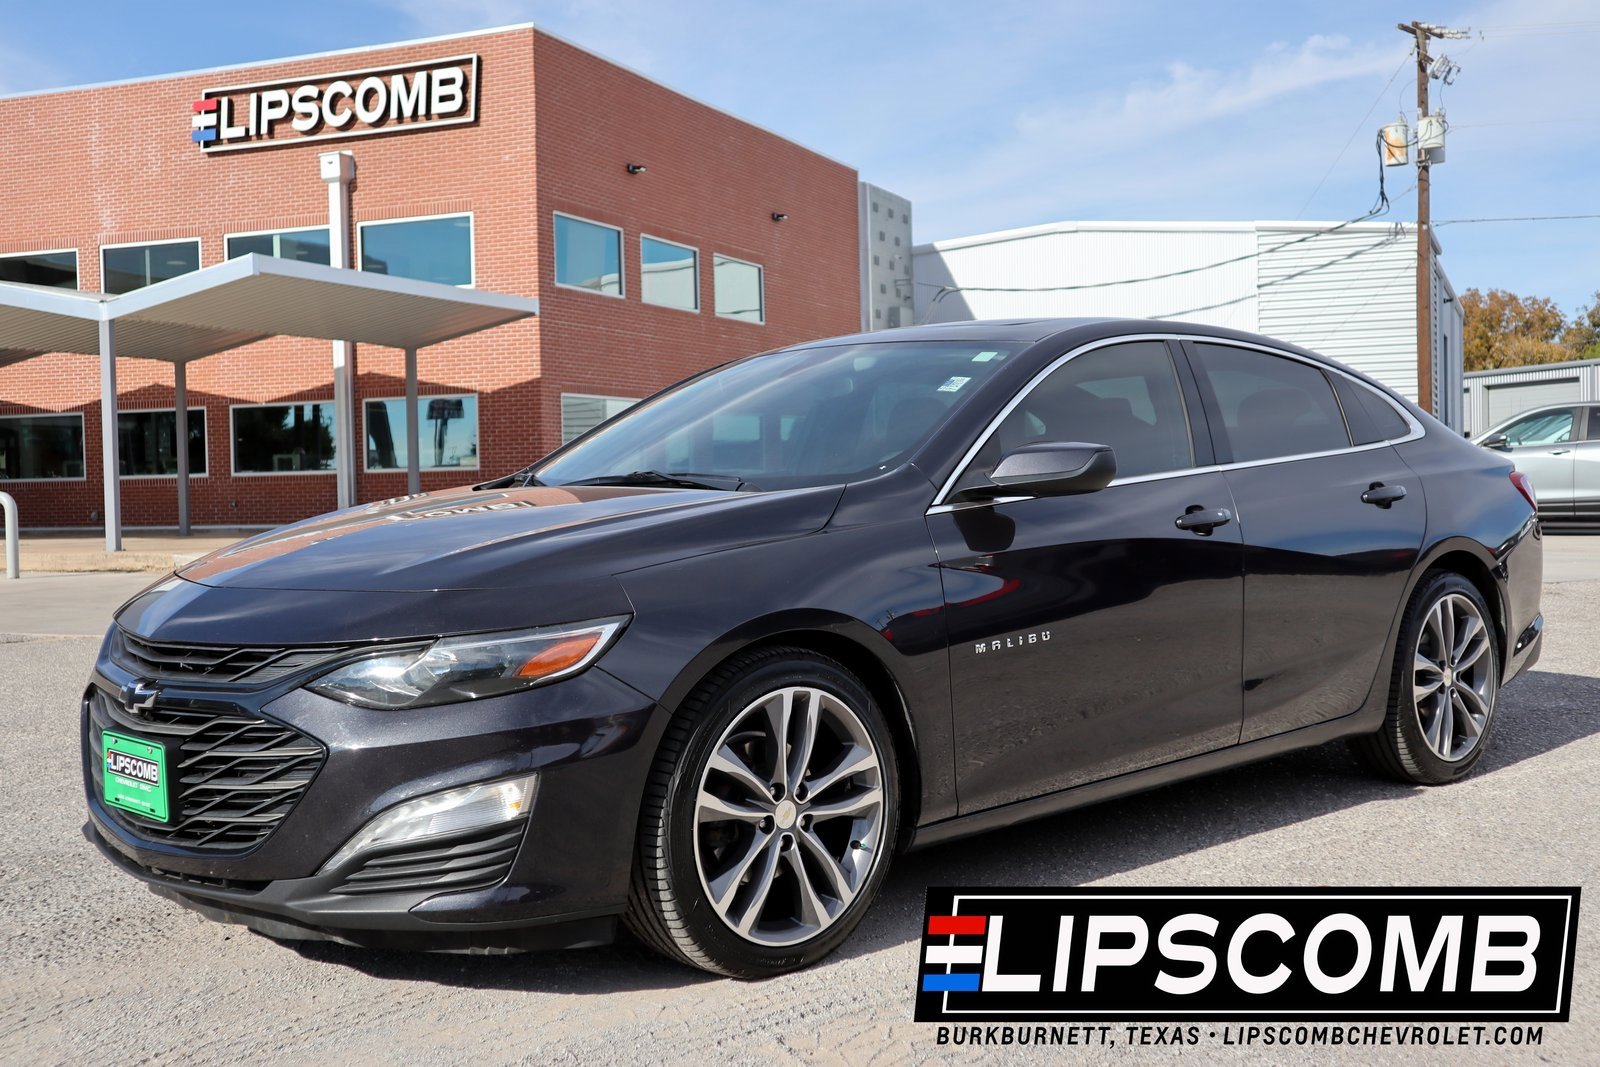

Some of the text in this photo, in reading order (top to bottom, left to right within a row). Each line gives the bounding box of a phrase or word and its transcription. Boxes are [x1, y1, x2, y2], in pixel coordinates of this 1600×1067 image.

[219, 66, 464, 140] LIPSCOMB
[975, 630, 1051, 654] MALIBU
[111, 752, 158, 782] LIPSCOMB
